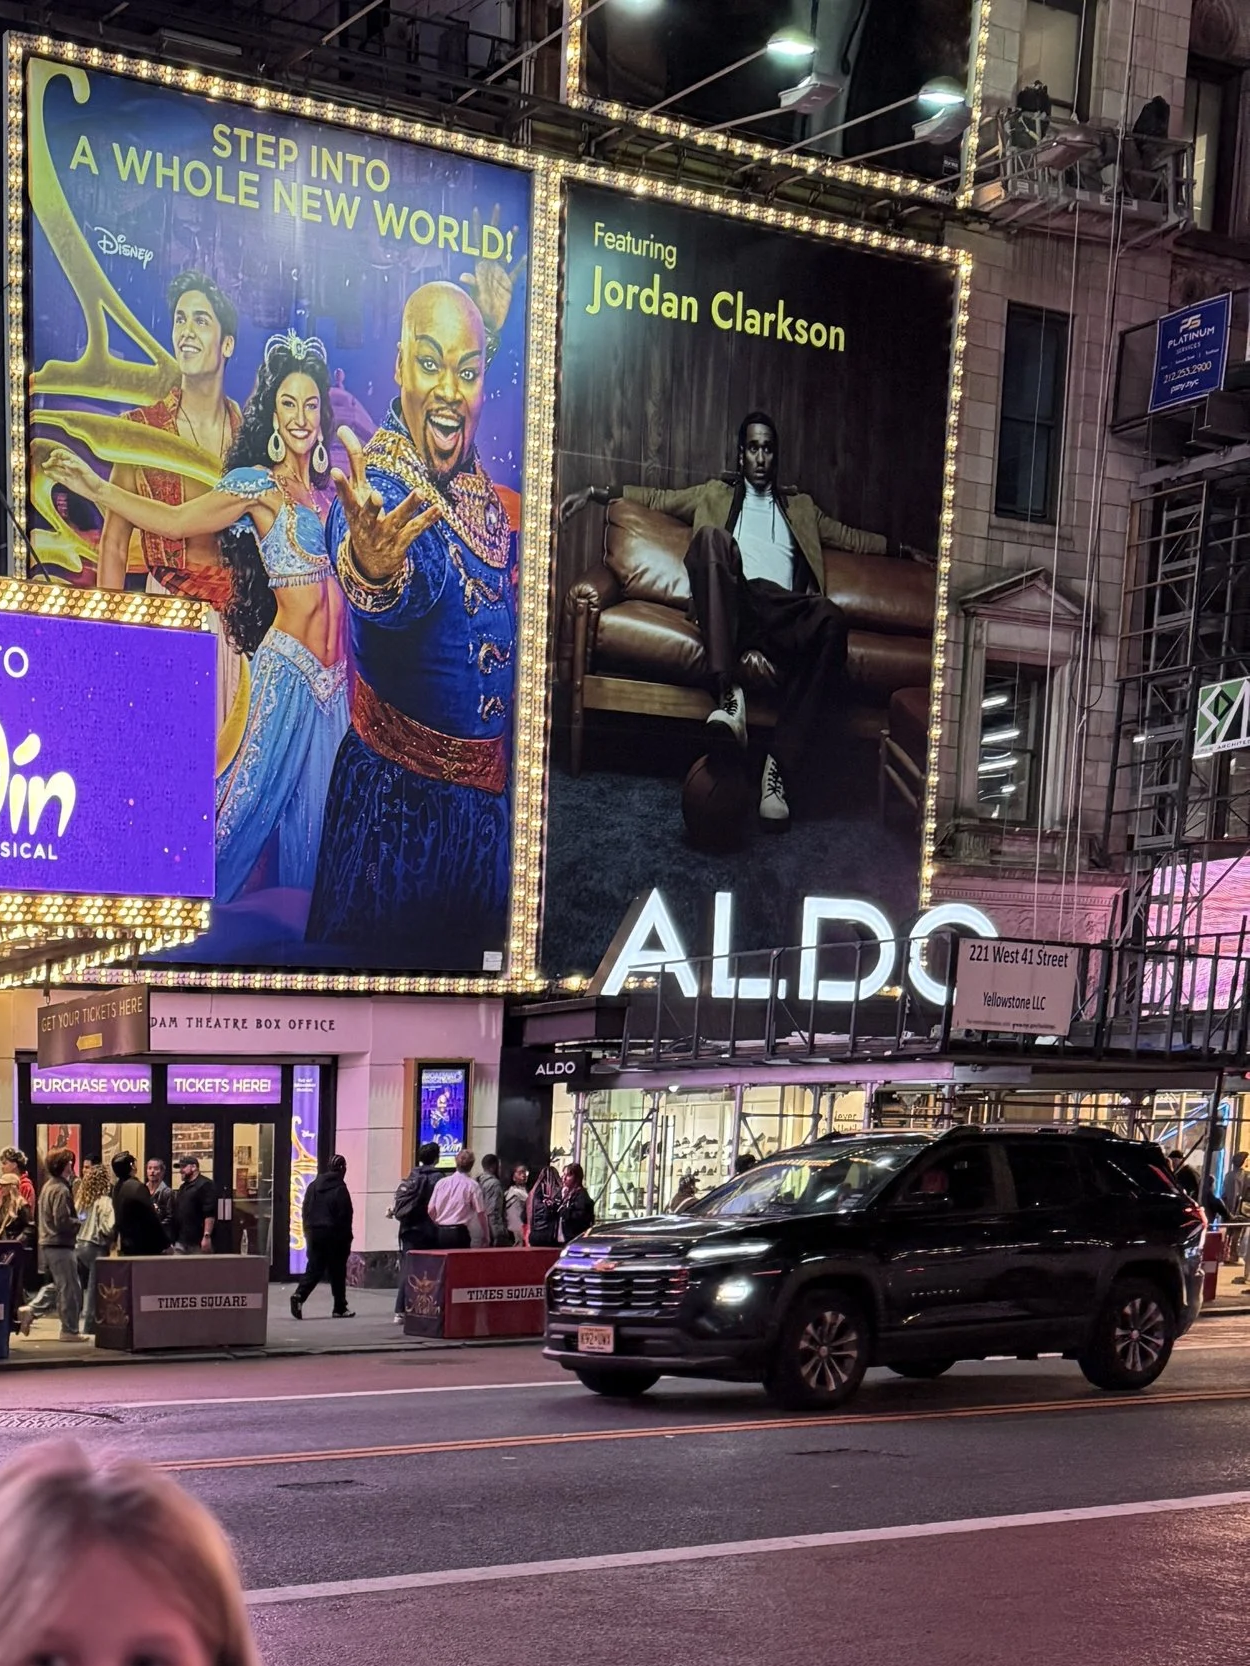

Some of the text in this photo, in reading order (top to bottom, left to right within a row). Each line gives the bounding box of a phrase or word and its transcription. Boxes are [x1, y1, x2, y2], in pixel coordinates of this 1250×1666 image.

[212, 123, 391, 193] STEP INTO
[69, 135, 514, 264] A WHOLE NEW WORLD!
[93, 226, 155, 270] Disney
[594, 221, 677, 270] Featuring
[585, 265, 845, 352] Jordan Clarkson
[1167, 326, 1215, 349] PLATINUM
[969, 944, 1069, 968] 221 West 41 Street
[983, 991, 1046, 1011] Yellowstone LLC
[41, 996, 143, 1033] GET YOUR TICKETS HERE
[186, 1017, 248, 1031] THEATRE
[255, 1018, 281, 1030] BOX
[288, 1019, 336, 1032] OFFICE
[535, 1061, 576, 1076] ALDO
[33, 1078, 150, 1093] PURCHASE YOUR
[174, 1078, 271, 1093] TICKETS HERE!
[158, 1295, 248, 1309] TIMES SQUARE
[467, 1289, 503, 1301] TIMES
